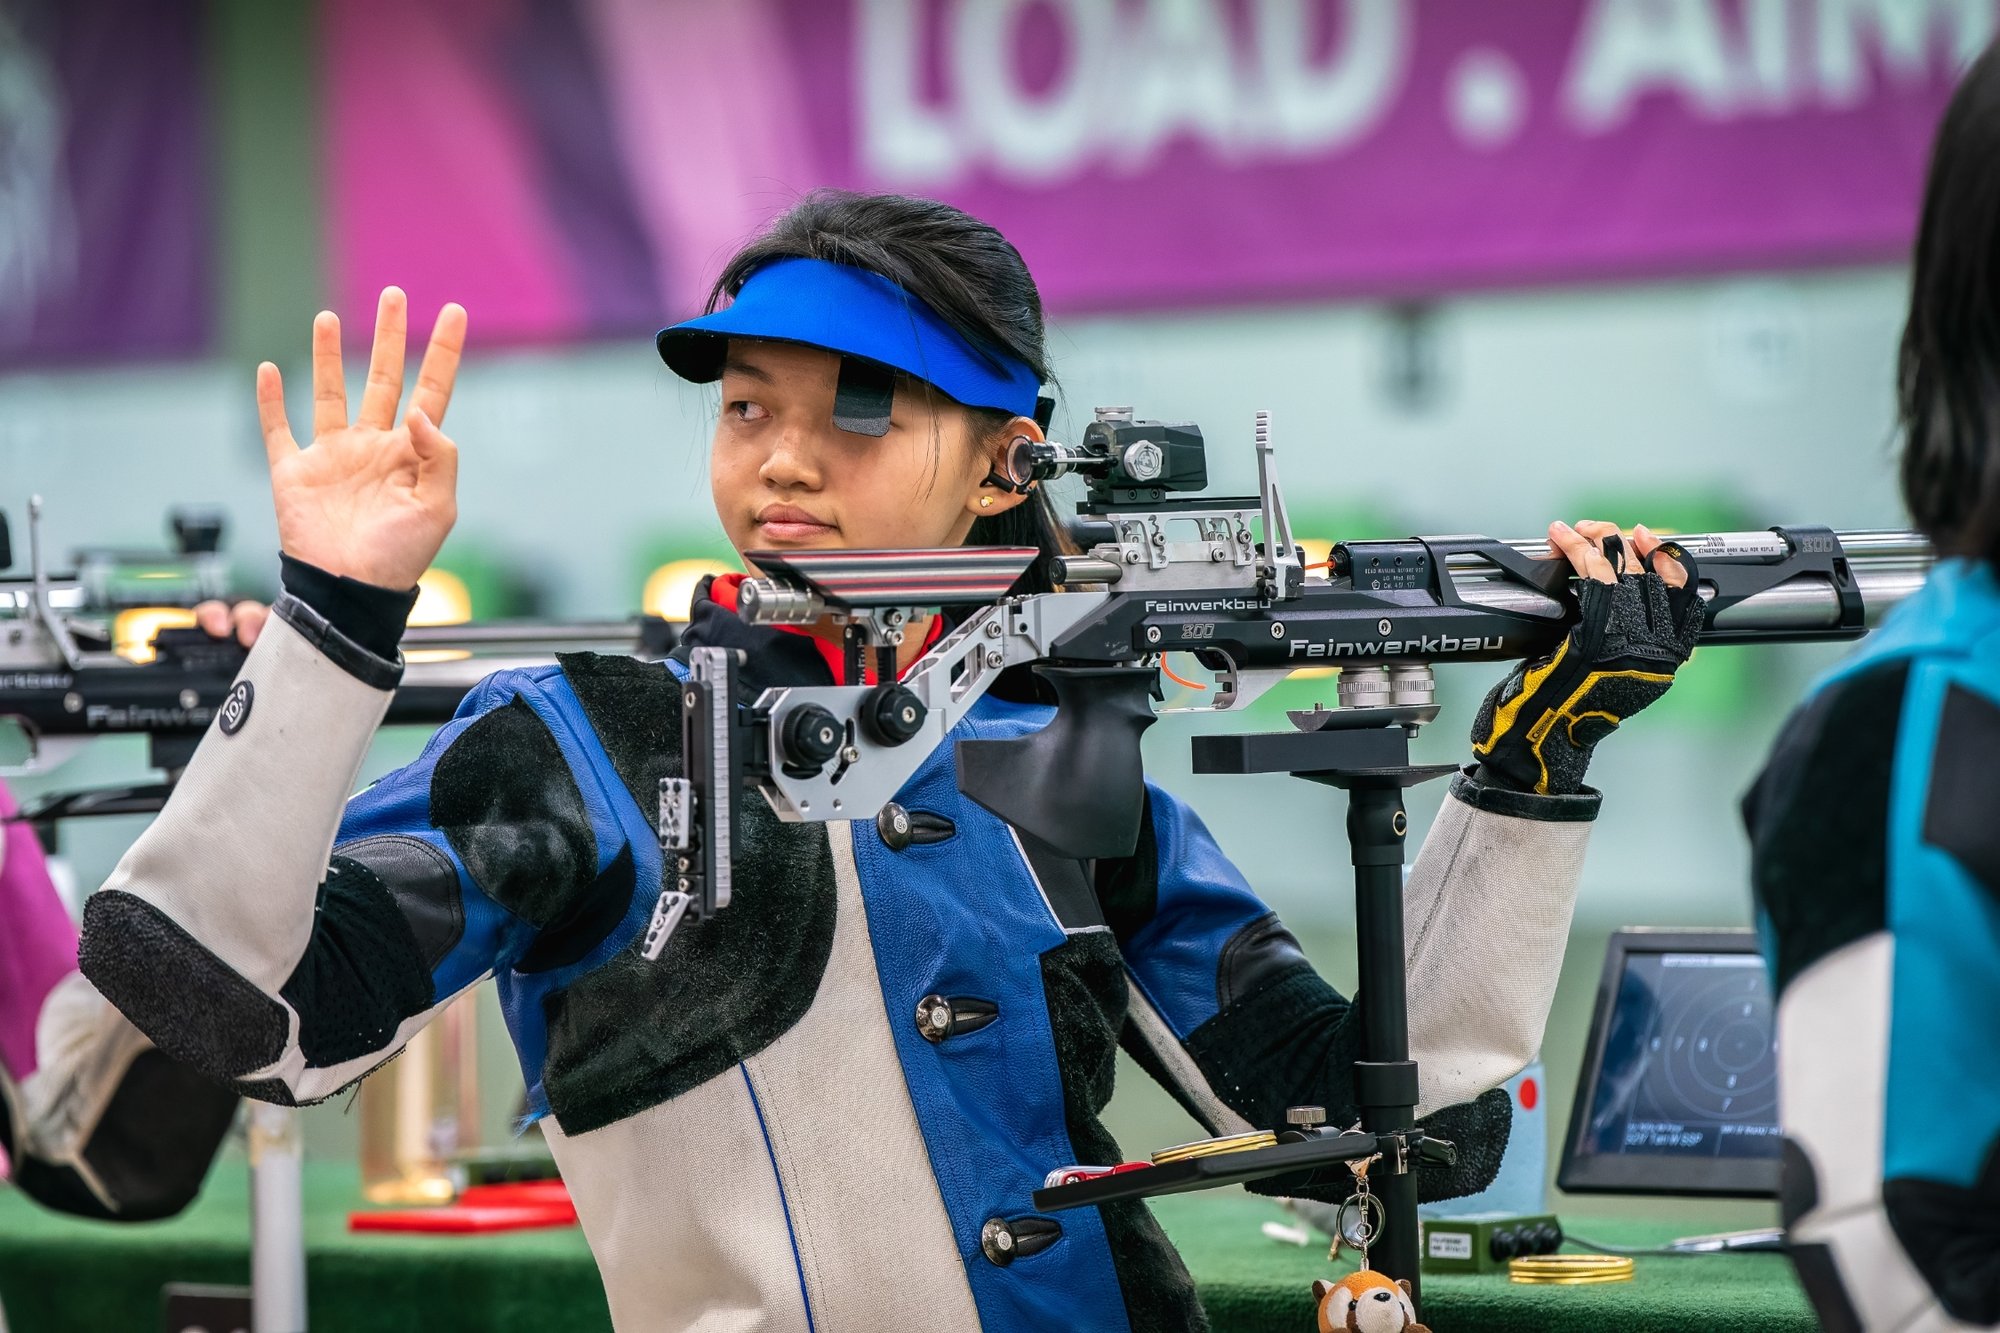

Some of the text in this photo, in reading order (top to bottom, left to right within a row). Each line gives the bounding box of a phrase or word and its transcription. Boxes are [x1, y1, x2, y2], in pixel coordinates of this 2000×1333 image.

[858, 0, 1405, 180] LOAD
[1145, 598, 1272, 612] Feinwerkbau
[1288, 634, 1504, 657] Feinwerkbau
